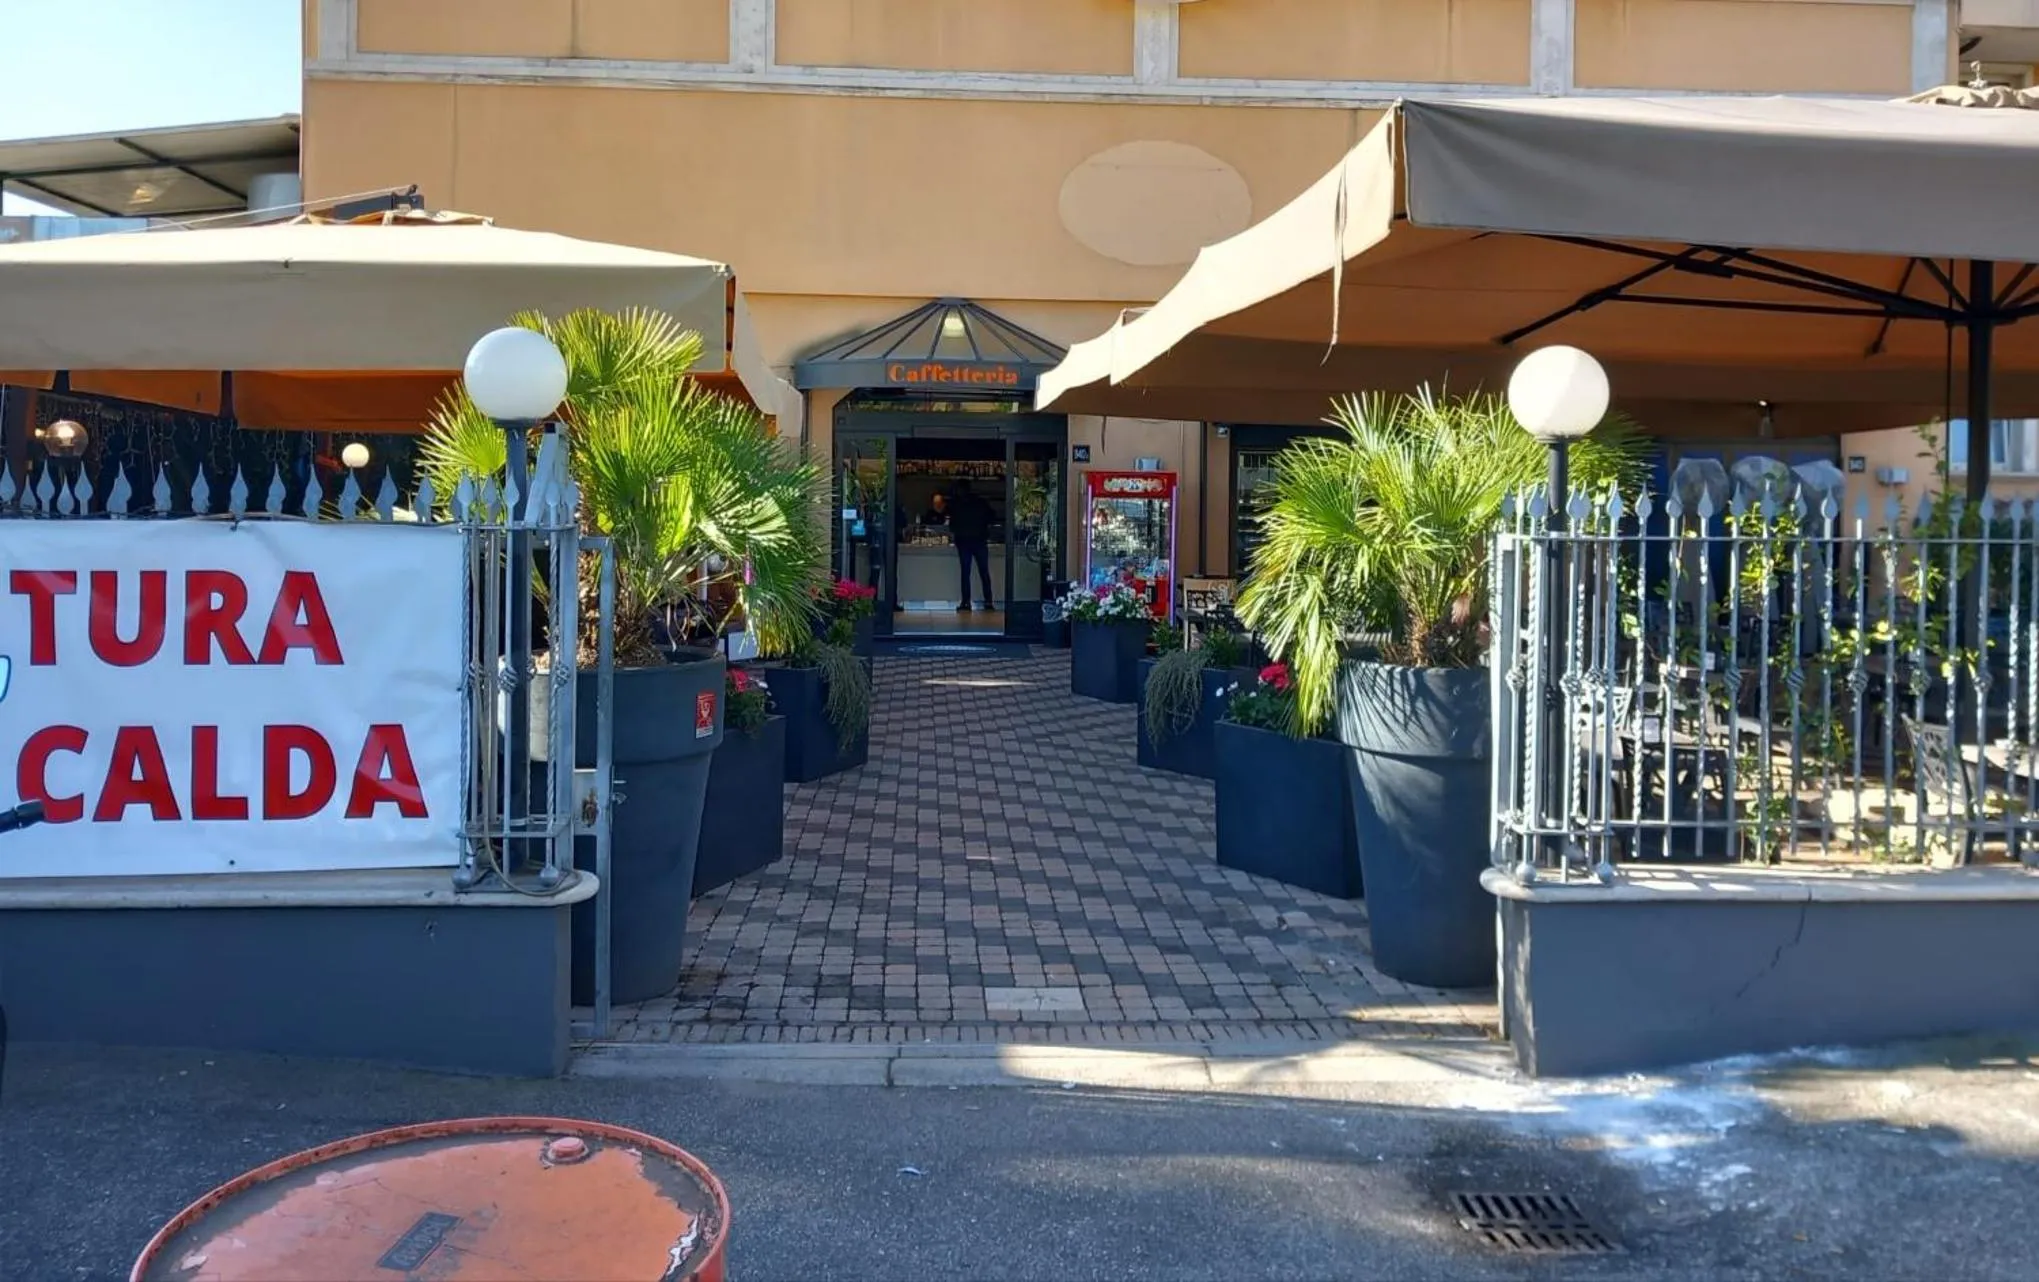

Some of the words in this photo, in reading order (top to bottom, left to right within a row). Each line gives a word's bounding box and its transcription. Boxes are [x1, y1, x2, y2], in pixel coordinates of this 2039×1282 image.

[888, 361, 1019, 384] Caffetteria
[10, 570, 344, 667] TURA
[17, 723, 429, 824] CALDA
